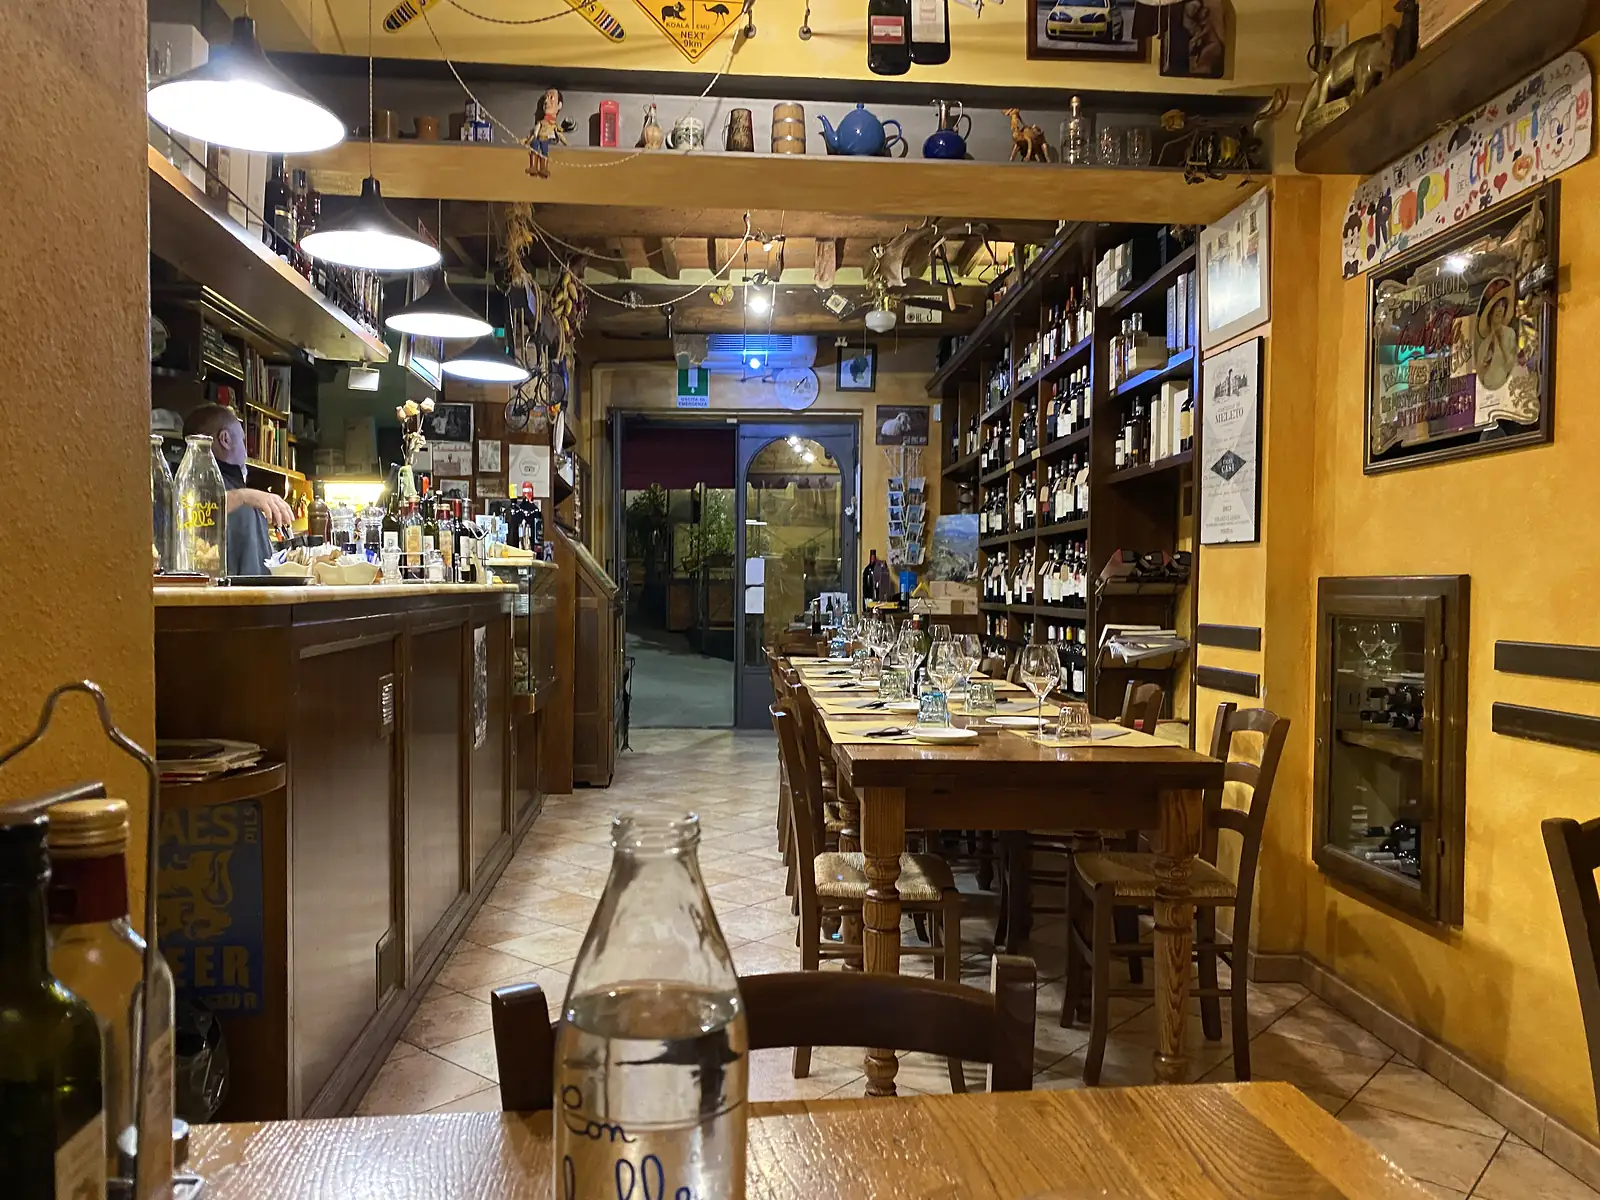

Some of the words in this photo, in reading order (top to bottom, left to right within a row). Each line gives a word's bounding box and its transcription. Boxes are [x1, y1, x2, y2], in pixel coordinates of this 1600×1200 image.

[666, 21, 690, 29] KOALA
[680, 31, 705, 40] NEXT
[683, 39, 702, 48] 9km
[1215, 407, 1244, 424] MELETO
[243, 806, 258, 844] PILS
